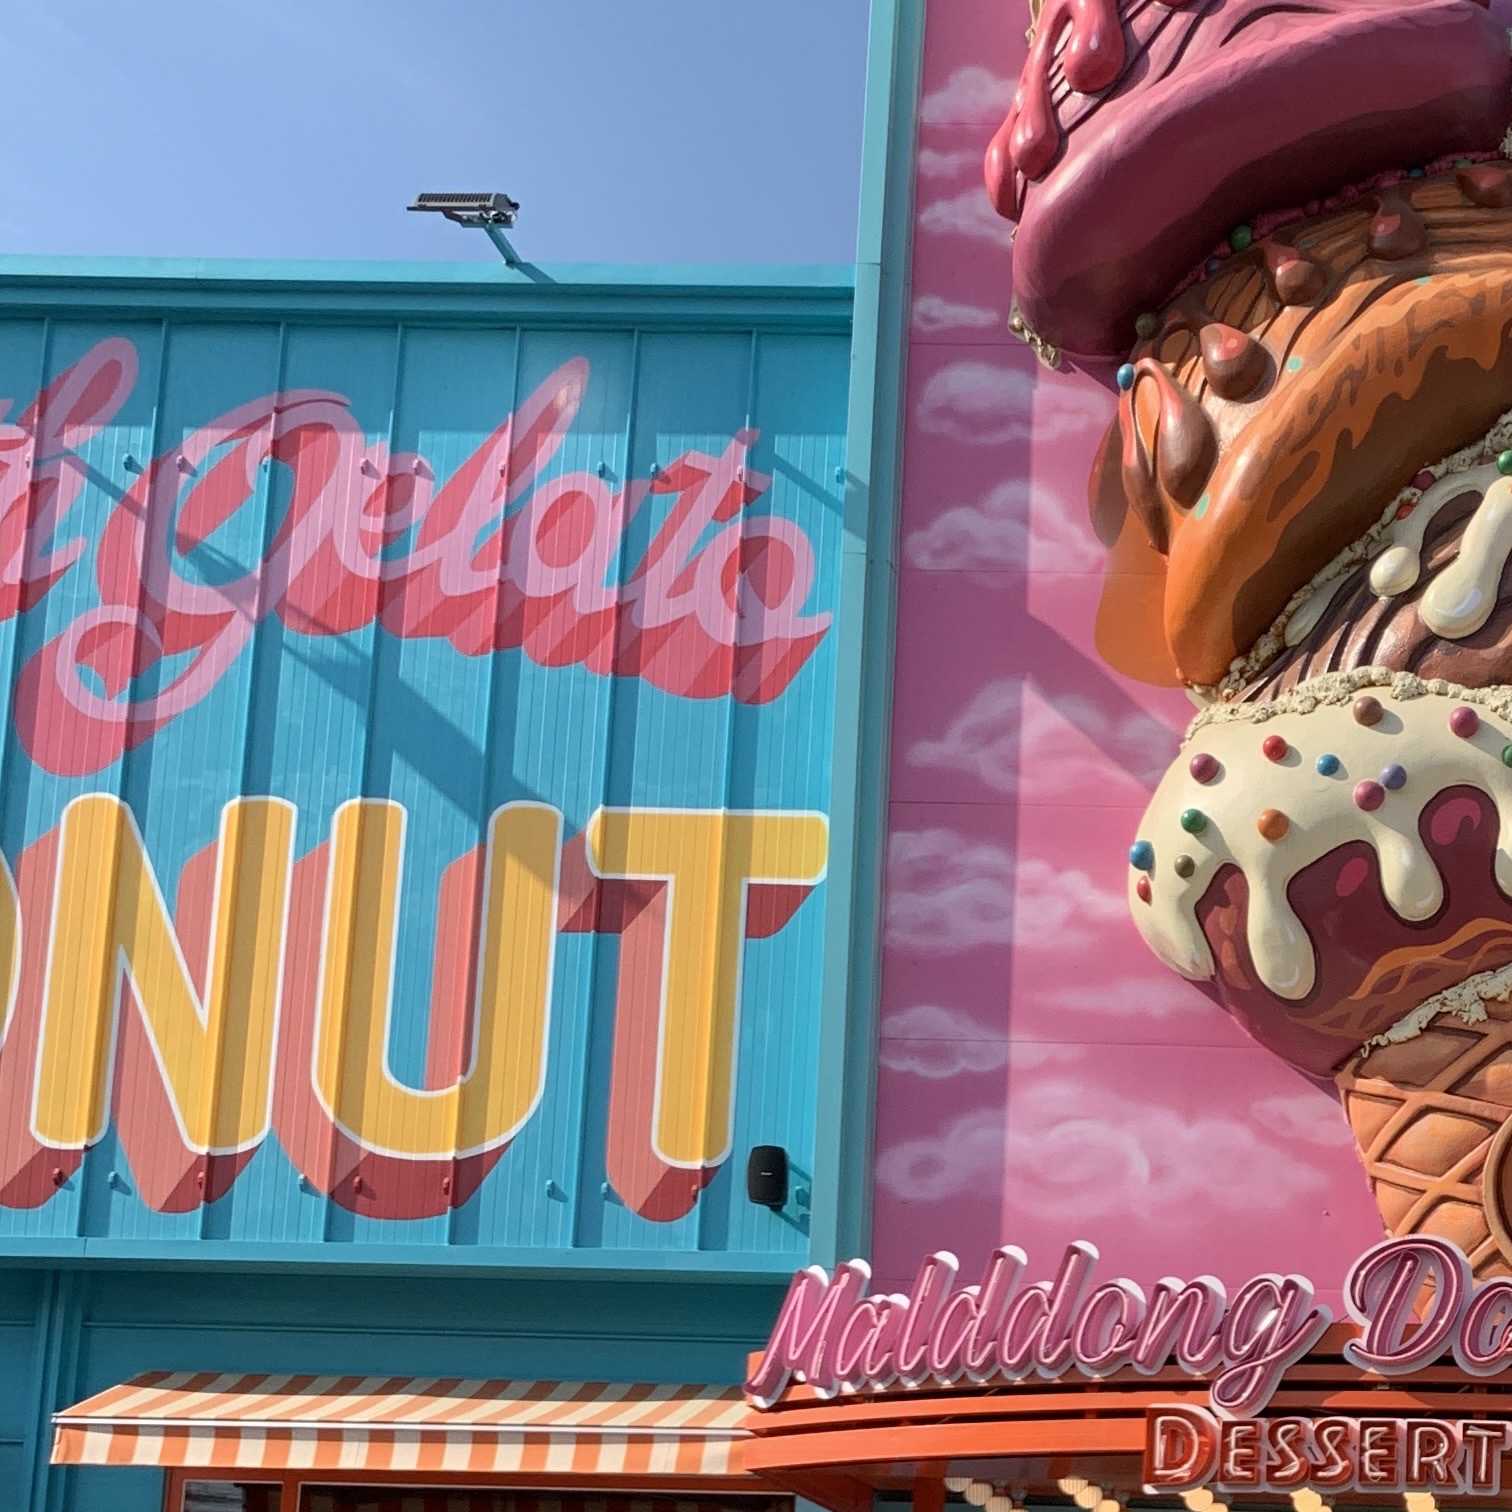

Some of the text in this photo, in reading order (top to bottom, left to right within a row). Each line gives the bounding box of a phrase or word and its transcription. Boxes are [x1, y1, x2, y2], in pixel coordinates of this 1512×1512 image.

[55, 356, 833, 724] Gelato
[0, 792, 830, 1170] NUT
[742, 1240, 1330, 1417] Malddong
[1142, 1403, 1512, 1496] DESSERT
